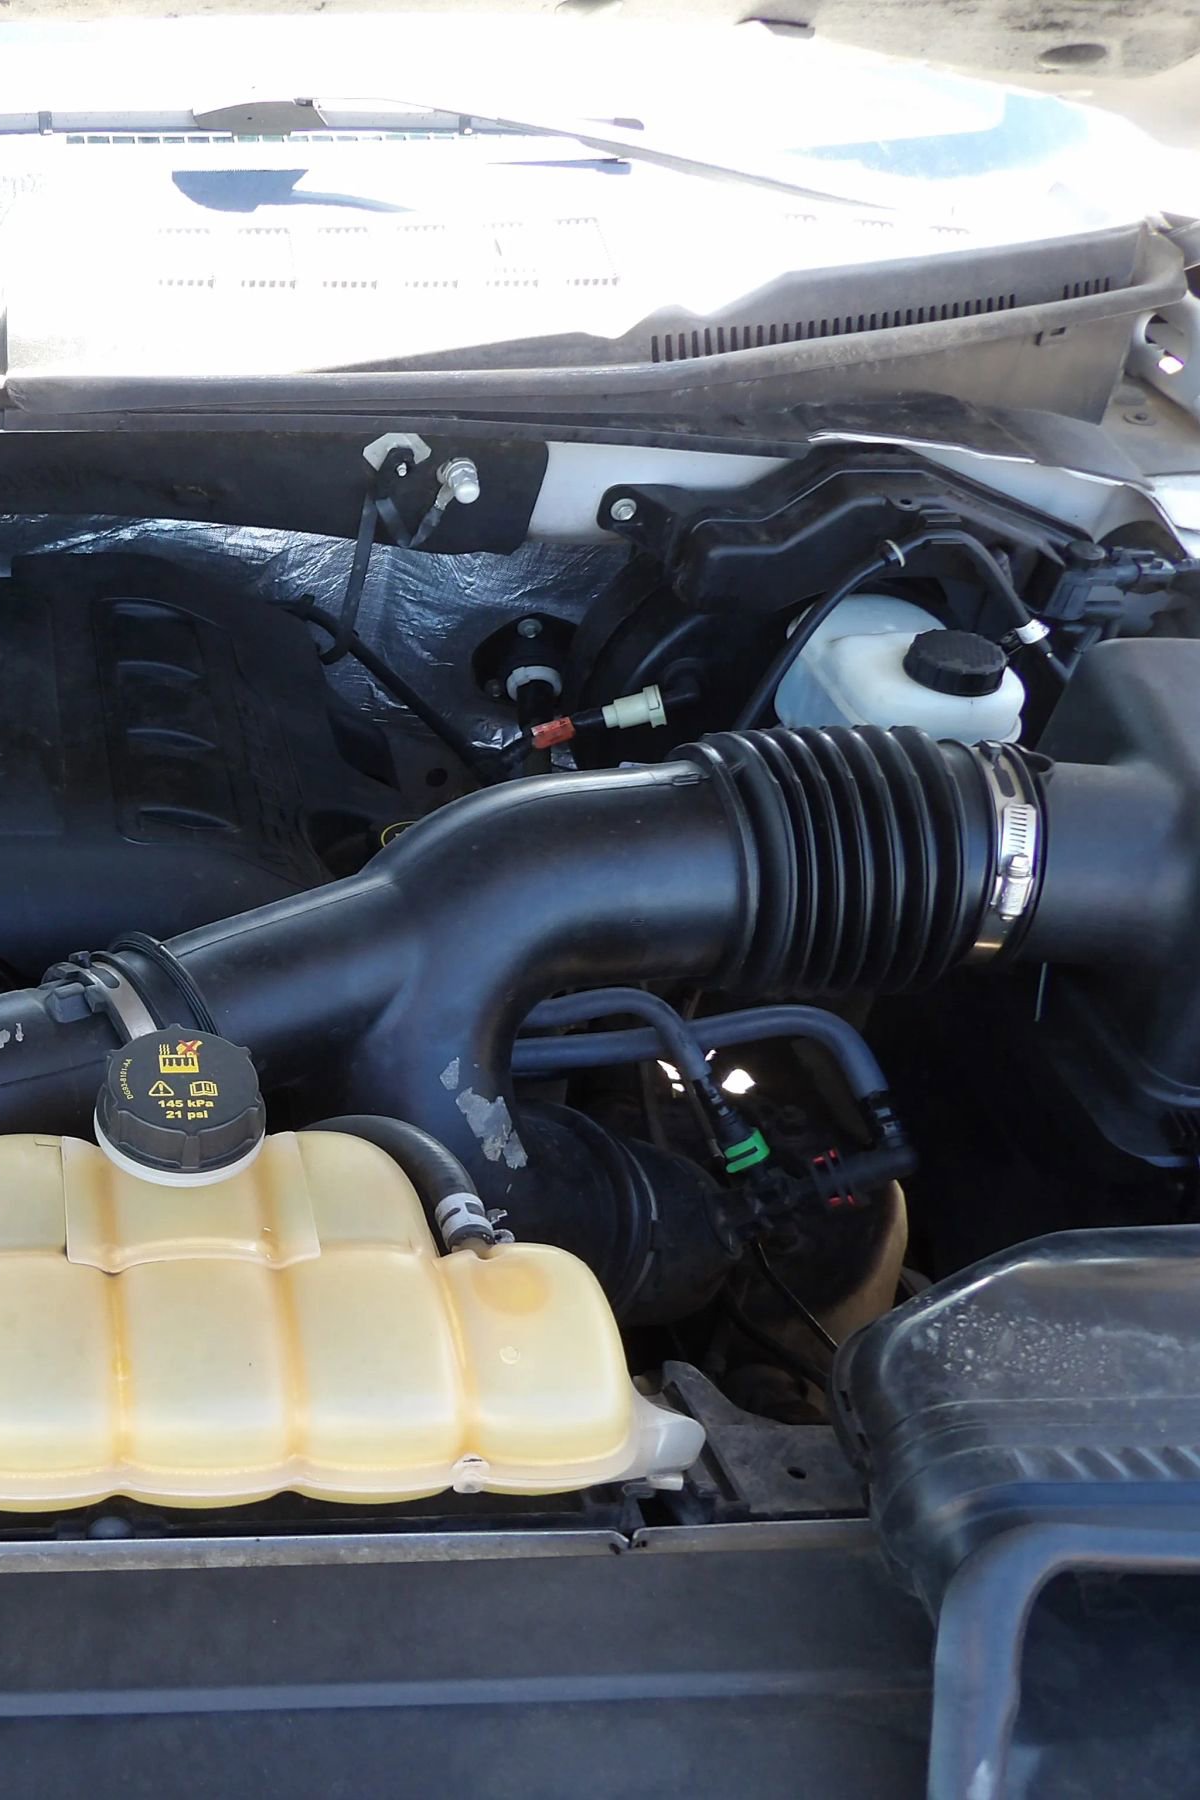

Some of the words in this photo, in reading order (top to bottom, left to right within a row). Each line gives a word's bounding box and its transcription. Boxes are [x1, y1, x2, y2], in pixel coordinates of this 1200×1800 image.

[158, 1099, 184, 1108] 145
[187, 1099, 214, 1108] kPa
[165, 1110, 183, 1119] 21
[187, 1110, 209, 1120] psi
